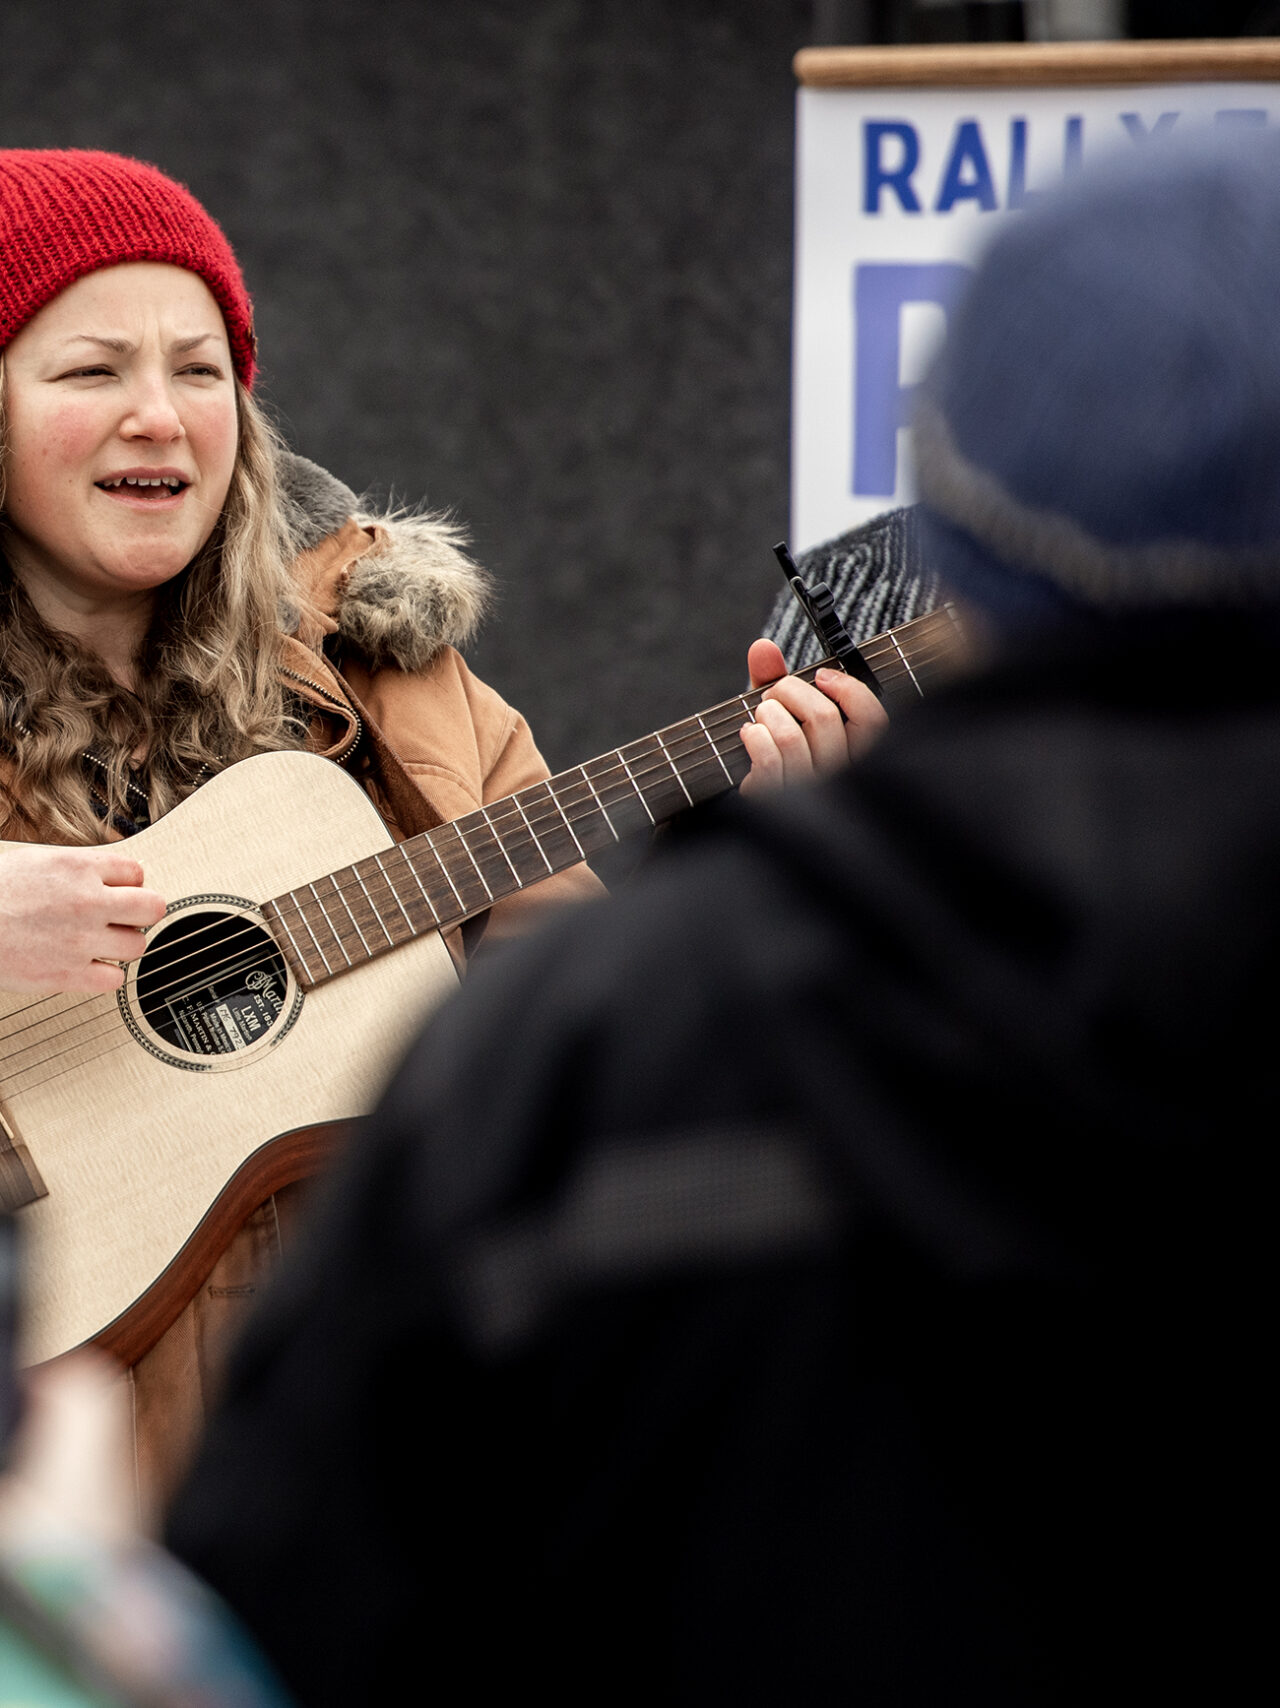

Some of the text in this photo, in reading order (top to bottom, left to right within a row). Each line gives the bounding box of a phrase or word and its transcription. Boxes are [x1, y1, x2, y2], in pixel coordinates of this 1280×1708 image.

[232, 1007, 243, 1021] Little
[240, 1004, 262, 1032] LXM
[253, 993, 275, 1027] EST. 183
[190, 1012, 210, 1044] MARTIN
[205, 1043, 213, 1052] &
[209, 1012, 221, 1028] Made
[216, 1027, 224, 1035] in
[227, 1026, 244, 1050] 792
